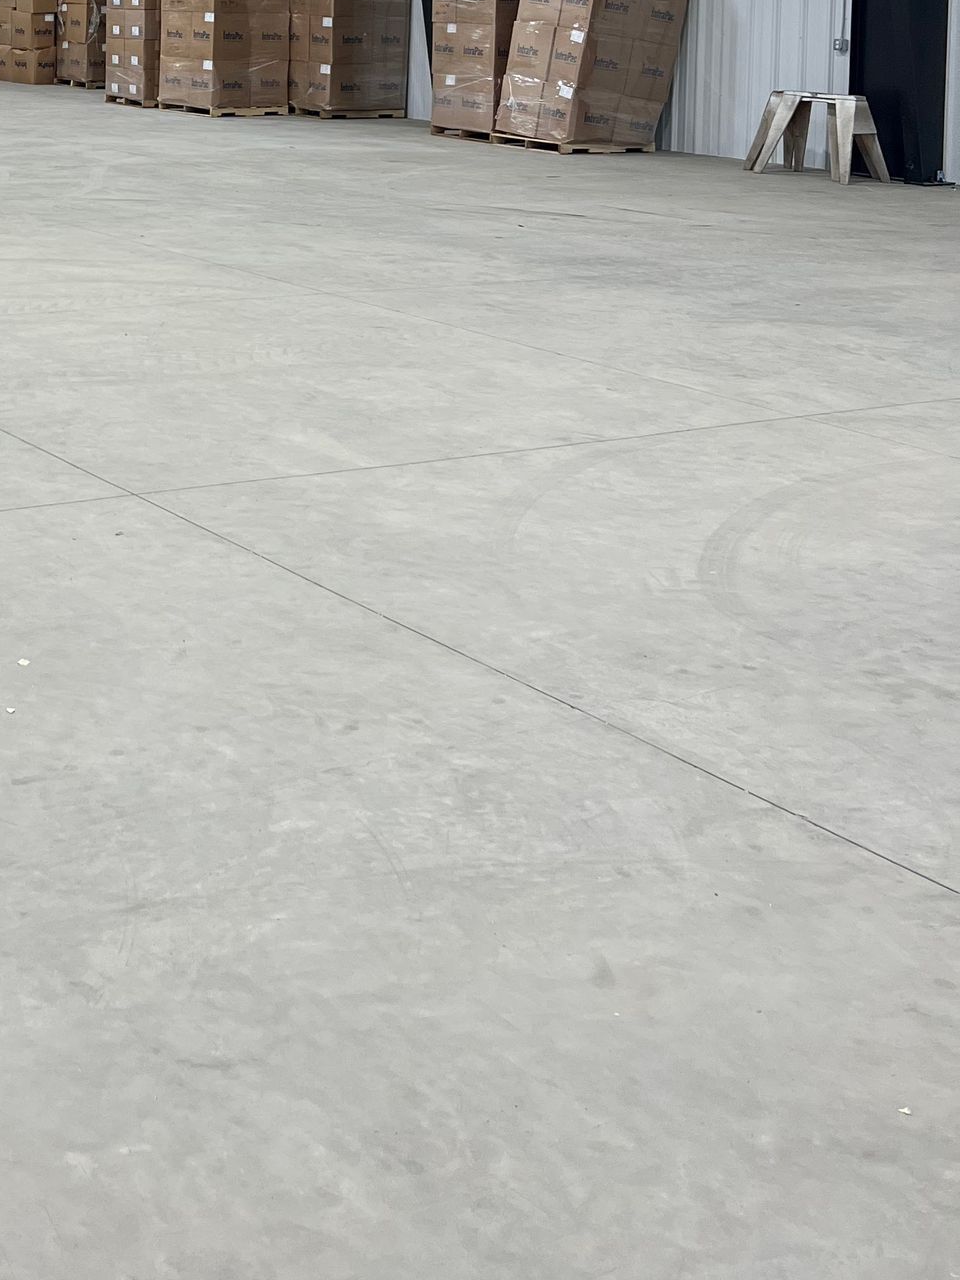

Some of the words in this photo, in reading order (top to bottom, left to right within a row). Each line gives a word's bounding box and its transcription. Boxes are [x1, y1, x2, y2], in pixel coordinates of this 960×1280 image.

[463, 45, 484, 56] IntraPac
[517, 42, 539, 56] IntraPac
[555, 48, 577, 63] IntraPac
[543, 104, 566, 119] IntraPac
